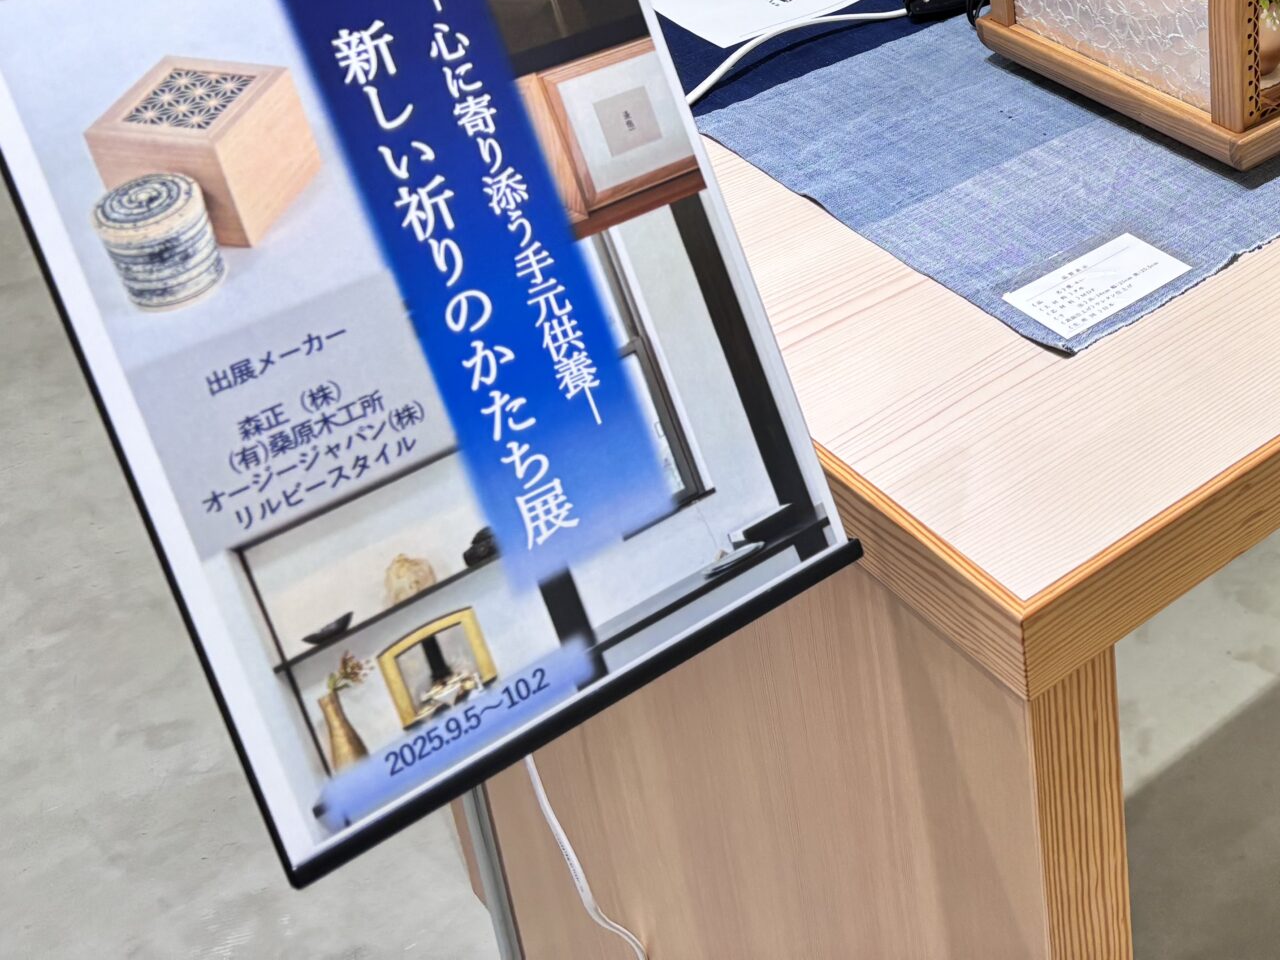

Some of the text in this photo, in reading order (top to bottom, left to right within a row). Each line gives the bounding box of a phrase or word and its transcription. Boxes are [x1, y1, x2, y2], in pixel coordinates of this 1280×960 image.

[331, 19, 580, 550] 新しい祈りのかたち展
[205, 328, 347, 397] 出展メーカー
[201, 400, 425, 515] オージージャパン(株)
[228, 389, 385, 475] (有)桑原木工所
[234, 436, 417, 530] リルビースタイル
